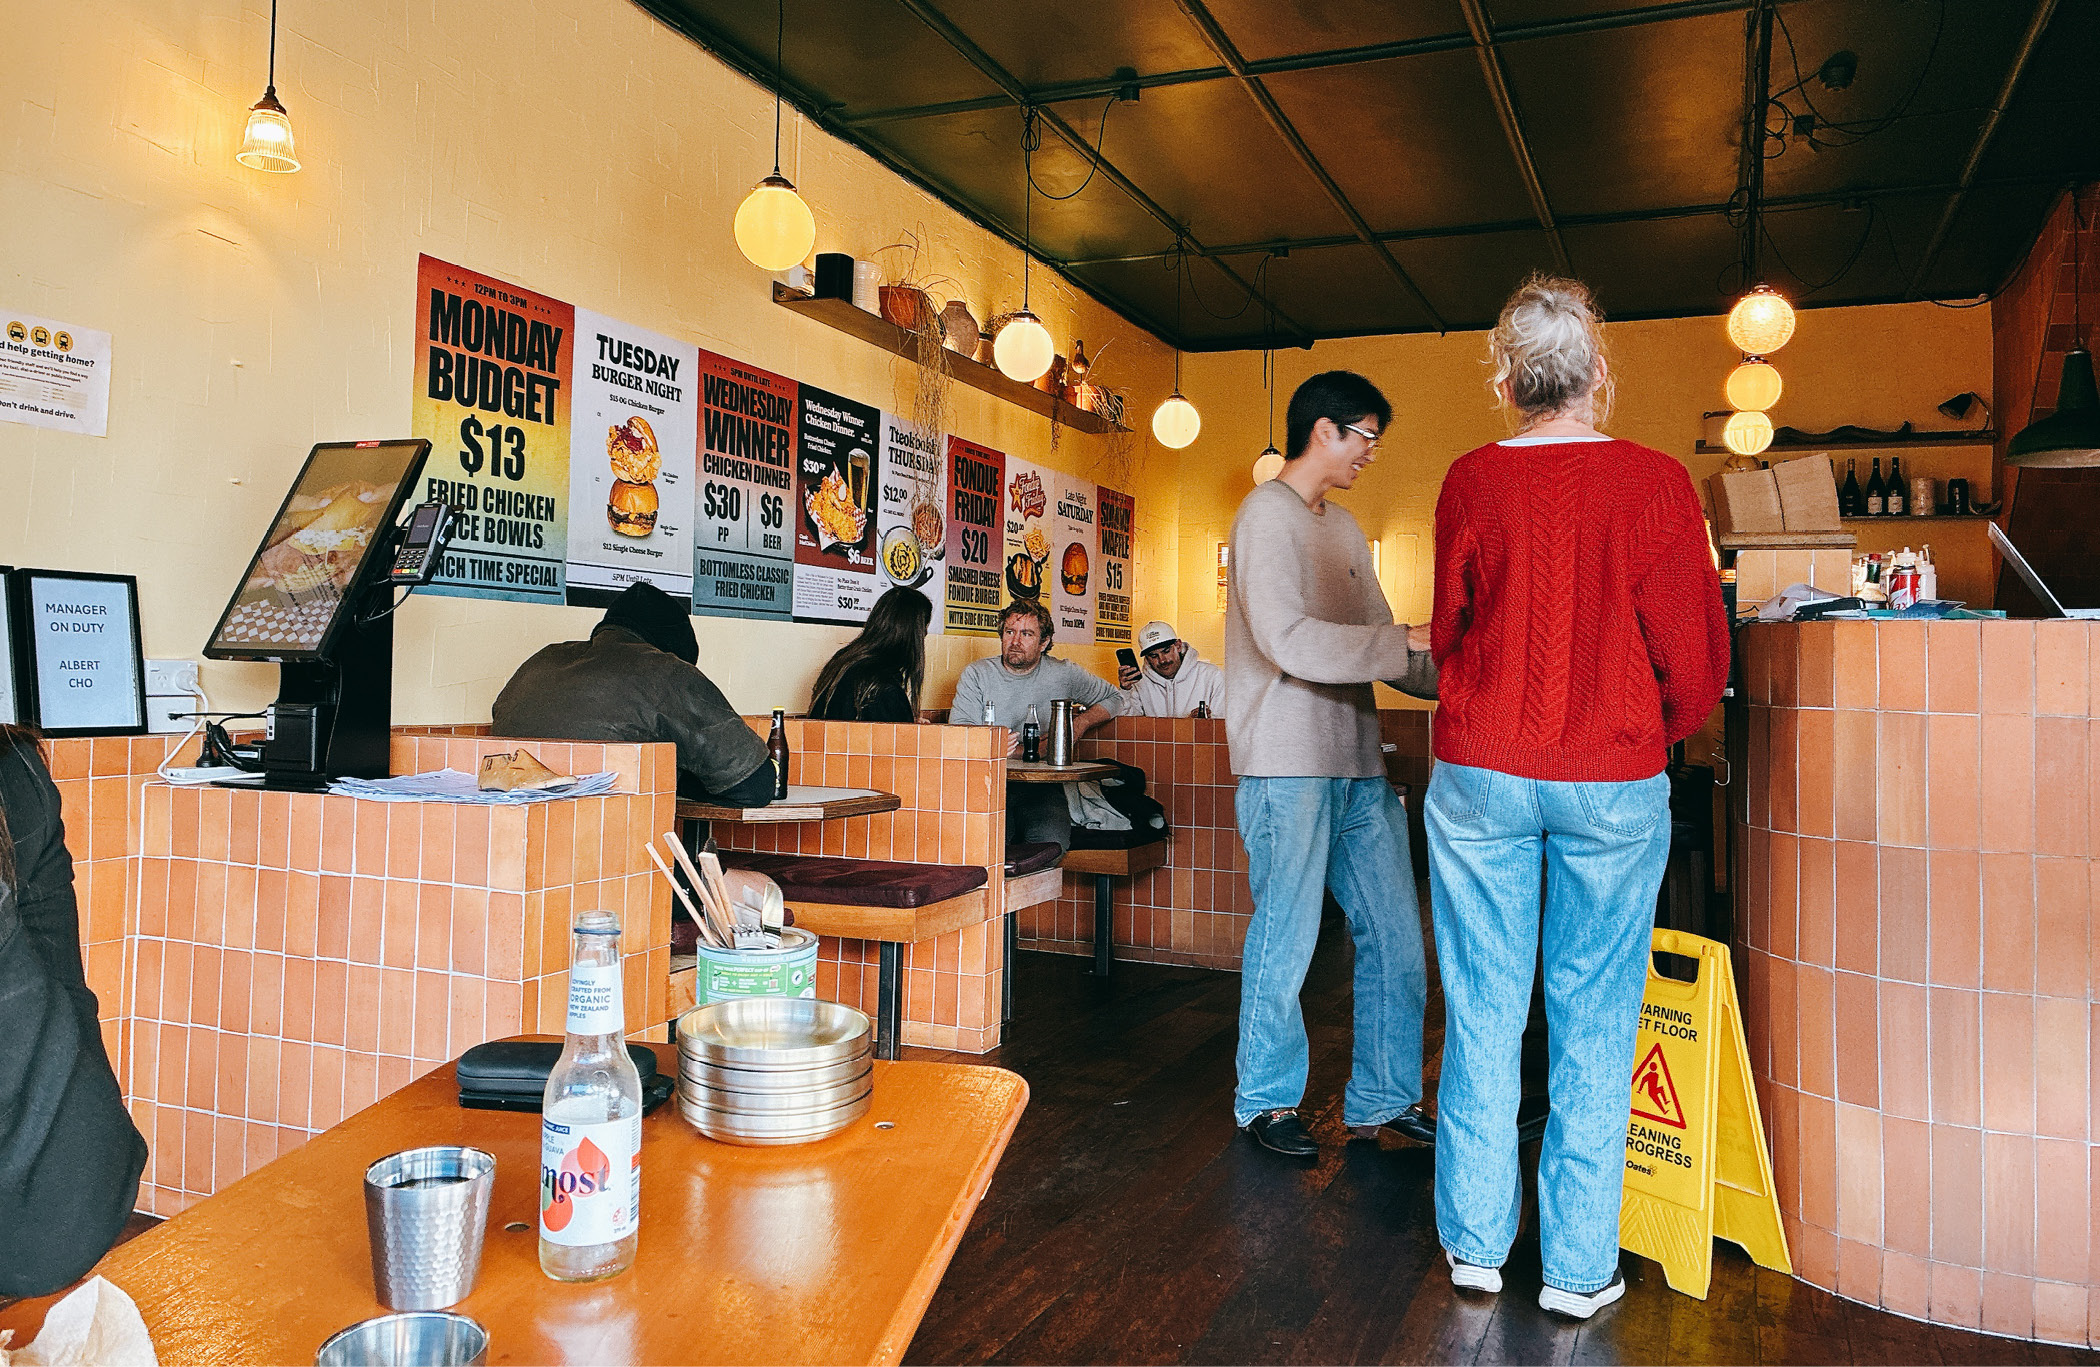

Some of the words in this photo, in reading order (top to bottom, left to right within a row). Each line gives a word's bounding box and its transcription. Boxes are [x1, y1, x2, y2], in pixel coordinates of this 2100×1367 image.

[474, 283, 496, 300] 12PM
[498, 291, 508, 303] TO
[510, 294, 527, 309] 3PM
[429, 288, 563, 374] MONDAY
[7, 342, 28, 355] help
[31, 348, 64, 363] getting
[66, 354, 95, 367] home?
[596, 333, 680, 382] TUESDAY
[428, 345, 561, 426] BUDGET
[592, 363, 643, 393] BURGER
[645, 379, 682, 403] NIGHT
[759, 376, 771, 388] LATE
[19, 403, 39, 413] drink
[40, 407, 54, 416] and
[54, 409, 76, 420] drive.
[703, 372, 793, 428] WEDNESDAY
[805, 399, 842, 422] Wednesday
[842, 411, 865, 428] Winner
[805, 413, 832, 431] Chicken
[832, 421, 856, 438] Dinner.
[460, 414, 526, 481] $13
[704, 406, 790, 469] WINNER
[703, 453, 752, 482] CHICKEN
[754, 464, 790, 490] DINNER
[803, 458, 820, 474] $30
[954, 454, 999, 497] FONDUE
[428, 478, 478, 511] FRIED
[482, 487, 556, 523] CHICKEN
[704, 480, 740, 522] $30
[760, 492, 783, 530] $6
[954, 488, 997, 529] FRIDAY
[1057, 500, 1094, 524] SATURDAY
[484, 517, 544, 549] BOWLS
[718, 526, 729, 542] PP
[763, 534, 782, 550] BEER
[962, 525, 988, 564] $20
[1102, 528, 1129, 560] WAFFLE
[602, 542, 612, 551] $12
[847, 547, 860, 566] $6
[434, 556, 466, 579] NCH
[469, 558, 503, 582] TIME
[506, 562, 558, 587] SPECIAL
[700, 558, 755, 580] BOTTOMLESS
[756, 565, 789, 584] CLASSIC
[948, 565, 978, 586] SMASHED
[979, 570, 1000, 588] CHEESE
[1106, 559, 1122, 590] $15
[715, 580, 738, 598] FRIED
[740, 582, 775, 602] CHICKEN
[838, 595, 853, 610] $30
[948, 584, 974, 602] FONDUE
[974, 587, 999, 606] BURGER
[46, 603, 108, 616] MANAGER
[948, 611, 963, 624] WITH
[964, 612, 976, 626] SIDE
[977, 613, 983, 626] OF
[50, 622, 69, 632] ON
[73, 622, 105, 634] DUTY
[59, 660, 100, 670] ALBERT
[68, 678, 93, 688] CHO
[571, 994, 610, 1004] ORGANIC
[1638, 1017, 1651, 1030] ET
[1654, 1021, 1697, 1042] FLOOR
[1627, 1123, 1681, 1149] EANING
[1626, 1137, 1692, 1168] ROGRESS
[1626, 1160, 1651, 1176] Oates
